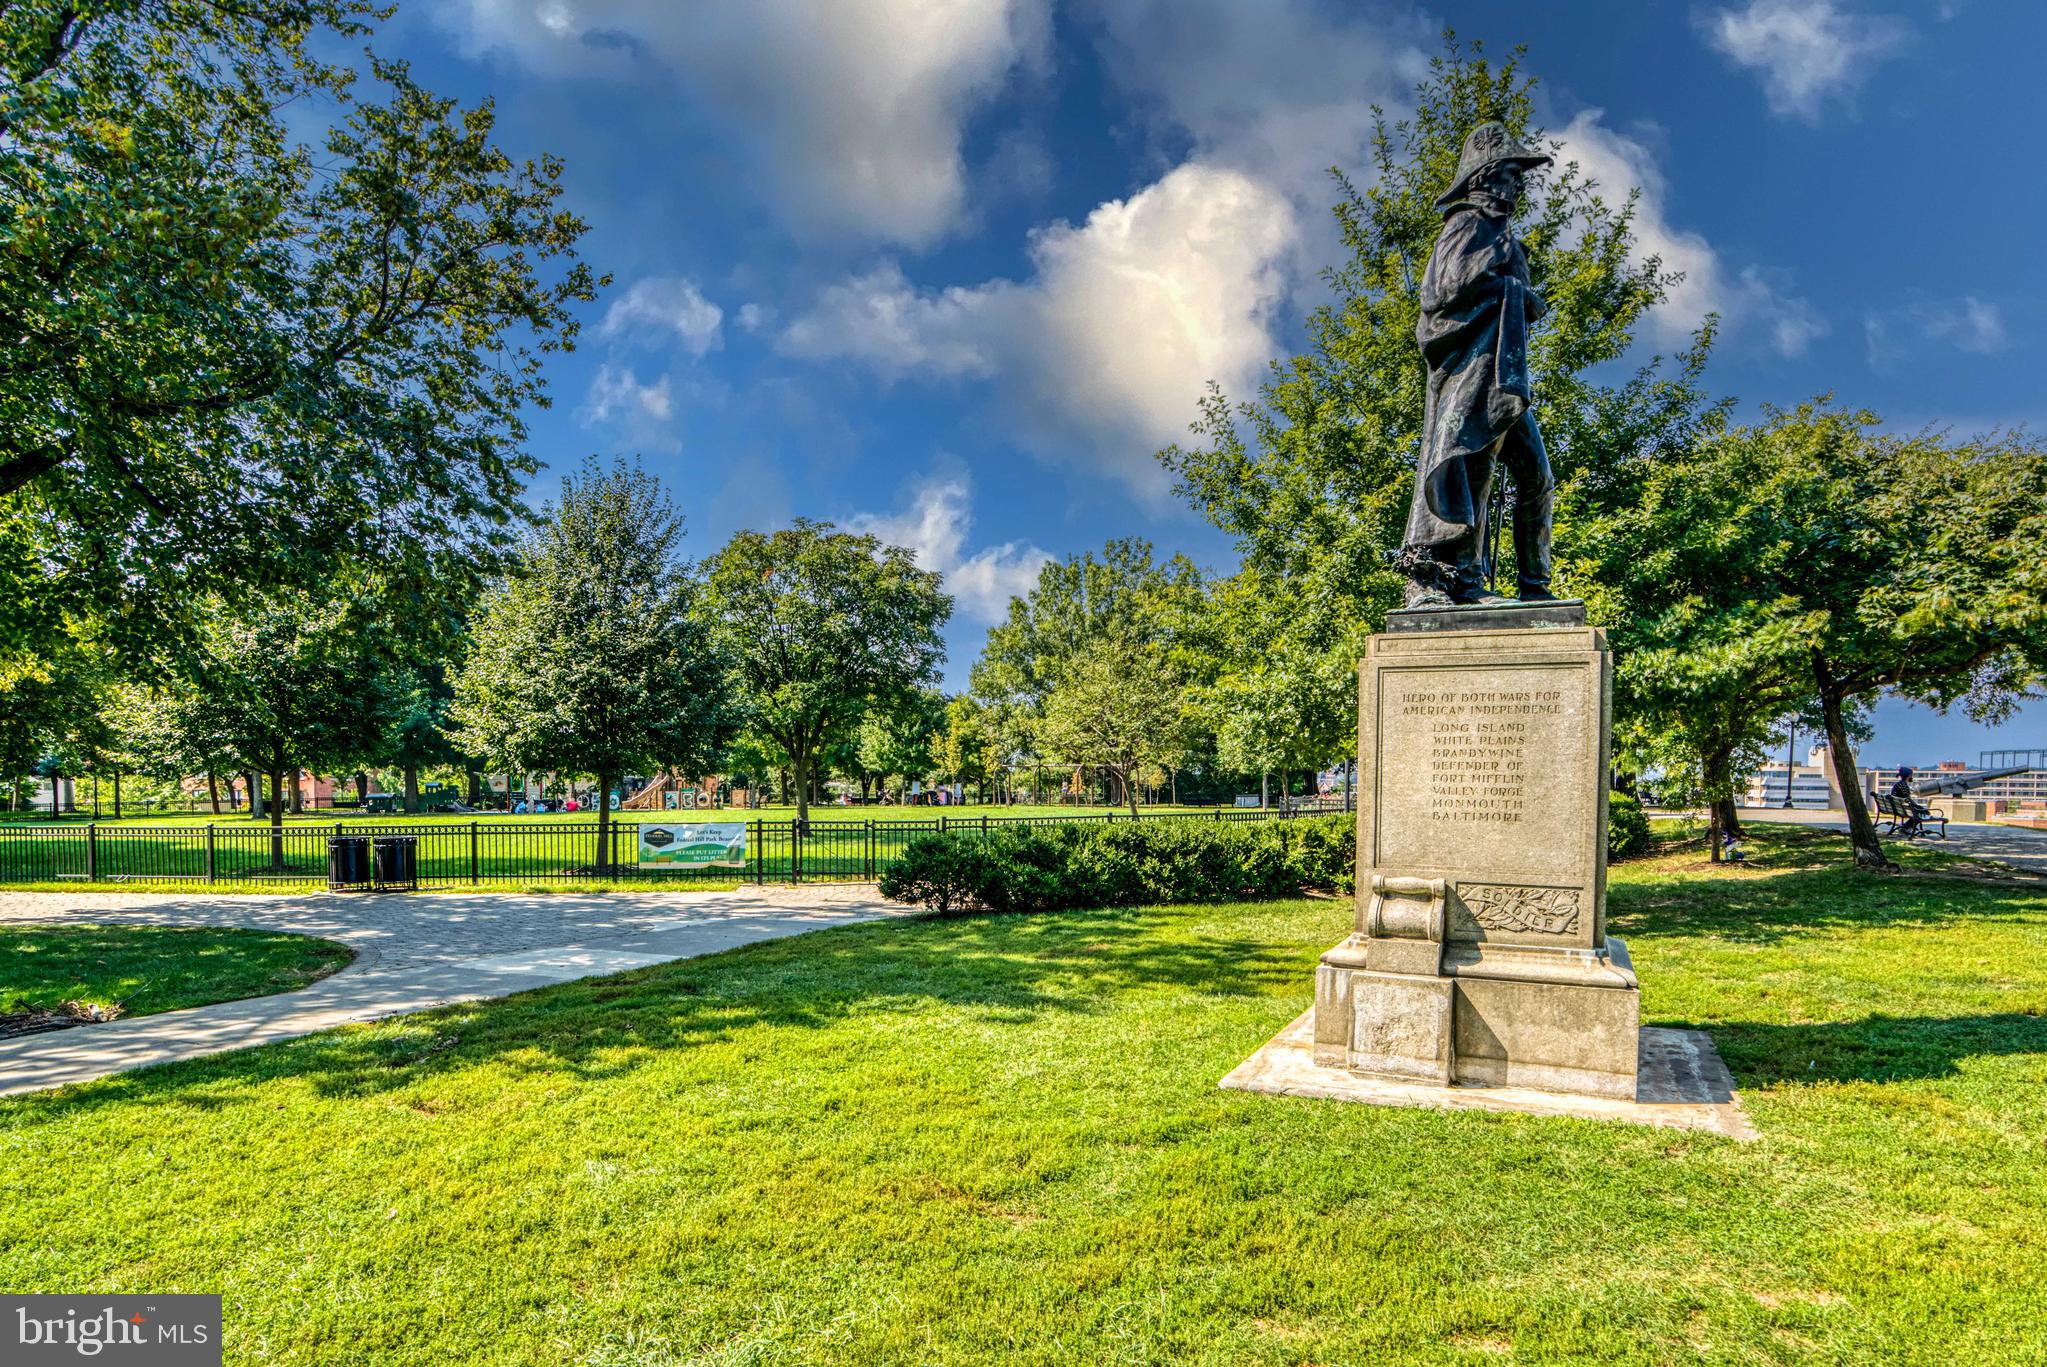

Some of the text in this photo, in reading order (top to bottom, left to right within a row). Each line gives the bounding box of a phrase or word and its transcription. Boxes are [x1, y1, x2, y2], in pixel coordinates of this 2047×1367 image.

[1402, 691, 1561, 703] HERO OF BOTH WARS FOR
[1402, 705, 1561, 715] AMERICAN INDEPENDENCE
[1432, 723, 1525, 733] LONG ISLAND
[1433, 736, 1526, 745] WHITE PLAINS
[1432, 749, 1524, 758] BRANDYWINE
[1432, 761, 1524, 771] DEFENDER OF
[1432, 774, 1525, 783] FORT MIFFLIN
[1432, 786, 1524, 796] VALLEY FORGE
[1432, 799, 1523, 809] MONMOUTH
[1432, 811, 1523, 821] BALTIMORE
[1482, 889, 1553, 929] SODIER
